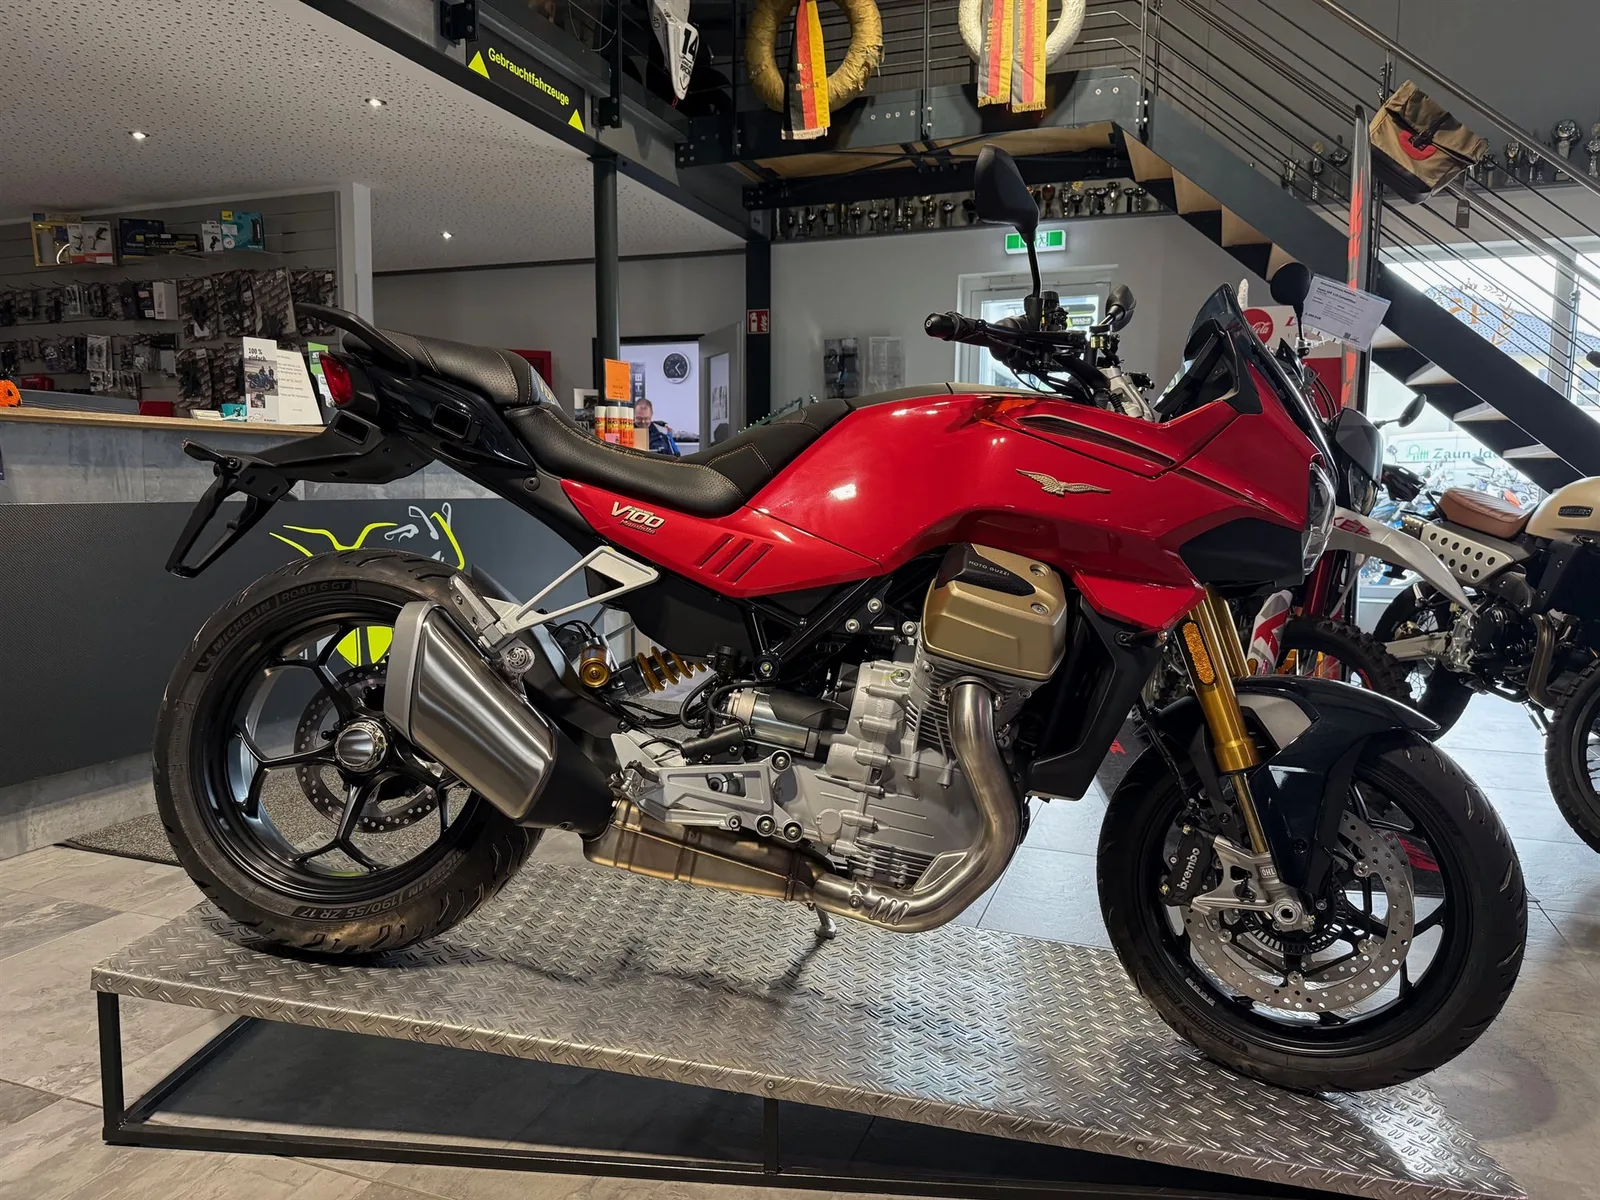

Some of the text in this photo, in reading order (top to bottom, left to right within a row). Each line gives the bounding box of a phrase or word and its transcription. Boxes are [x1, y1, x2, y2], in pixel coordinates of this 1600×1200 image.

[682, 28, 698, 61] 14
[488, 47, 570, 106] Gebrauchtfahrzeuge
[611, 501, 666, 528] V100
[968, 560, 1010, 576] MOTO GUZZI
[282, 580, 349, 601] ROAD 6 GT
[213, 602, 271, 652] MICHELIN
[1177, 847, 1200, 890] brembo
[298, 907, 315, 918] 17
[319, 909, 345, 920] ZR
[344, 896, 398, 918] 190/55
